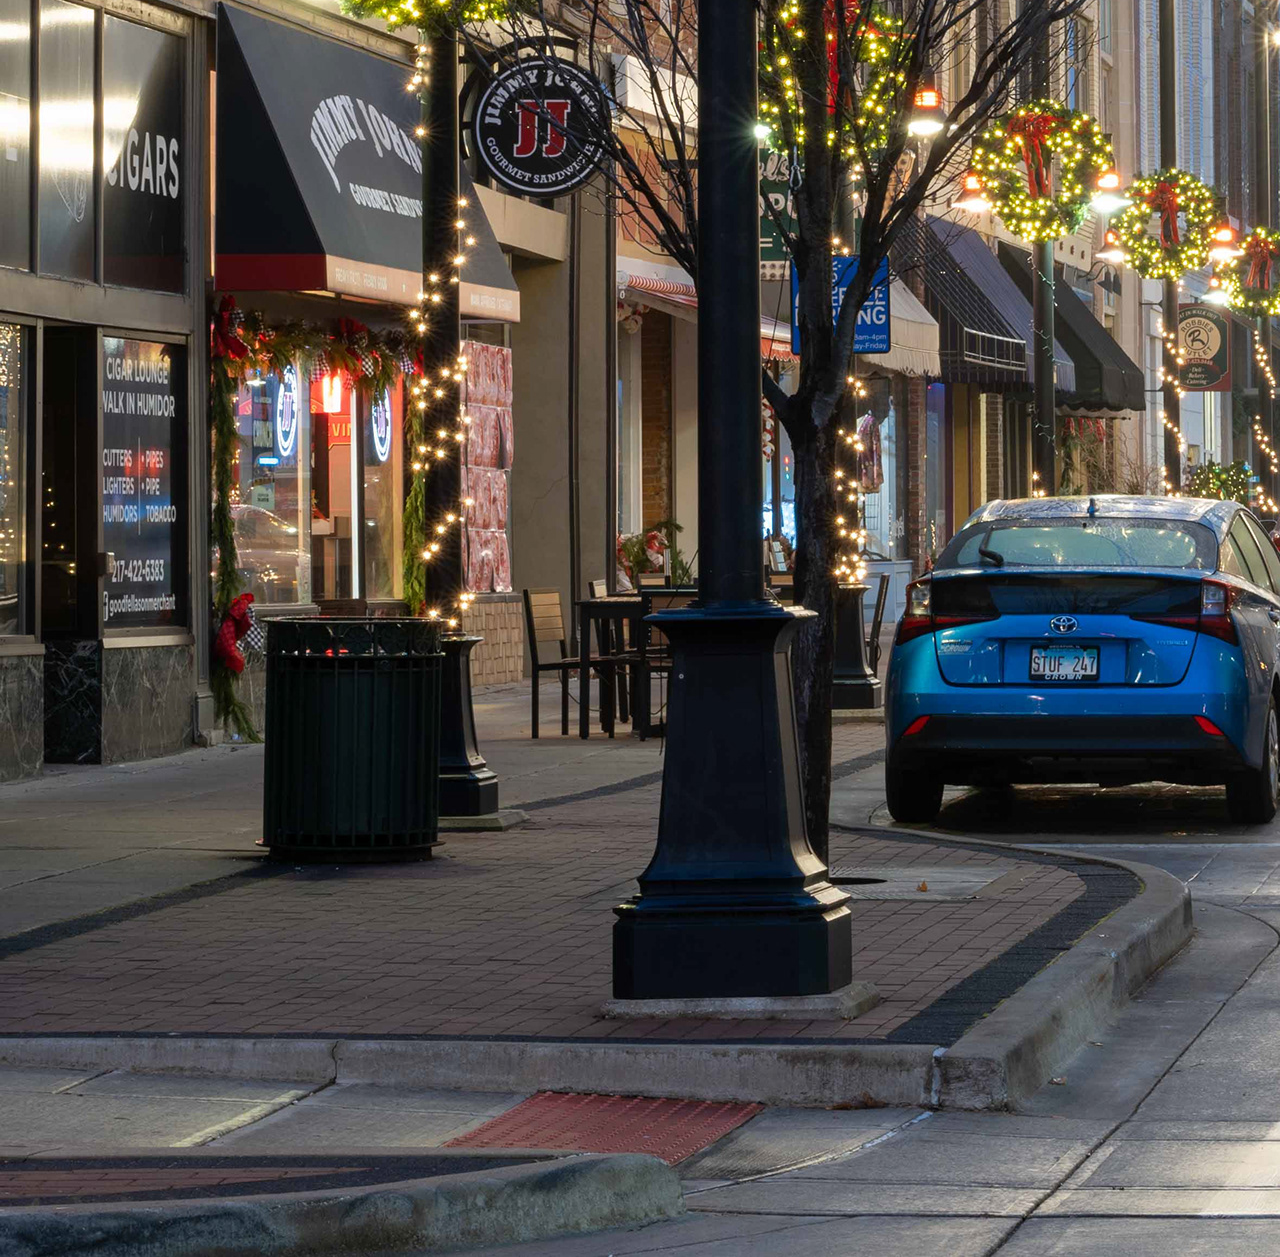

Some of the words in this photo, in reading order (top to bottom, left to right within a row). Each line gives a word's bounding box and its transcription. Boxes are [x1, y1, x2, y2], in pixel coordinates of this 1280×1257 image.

[513, 99, 571, 158] JJ
[310, 95, 366, 193] JIMMY
[487, 137, 532, 182] GOURMET
[349, 183, 395, 213] GOURMET
[1181, 319, 1214, 333] ROBBIES
[106, 357, 133, 381] CIGAR
[135, 359, 168, 384] LOUNGE
[126, 393, 135, 415] IN
[137, 394, 175, 417] HUMIDOR
[103, 449, 132, 467] CUTTERS
[146, 450, 163, 468] PIPES
[103, 477, 134, 494] LIGHTERS
[146, 478, 160, 495] PIPE
[103, 505, 137, 523] HUMIDORS
[146, 505, 176, 523] TOBACCO
[112, 560, 164, 582] 217-422-6383
[1033, 656, 1065, 672] STUF
[1072, 656, 1096, 672] 247
